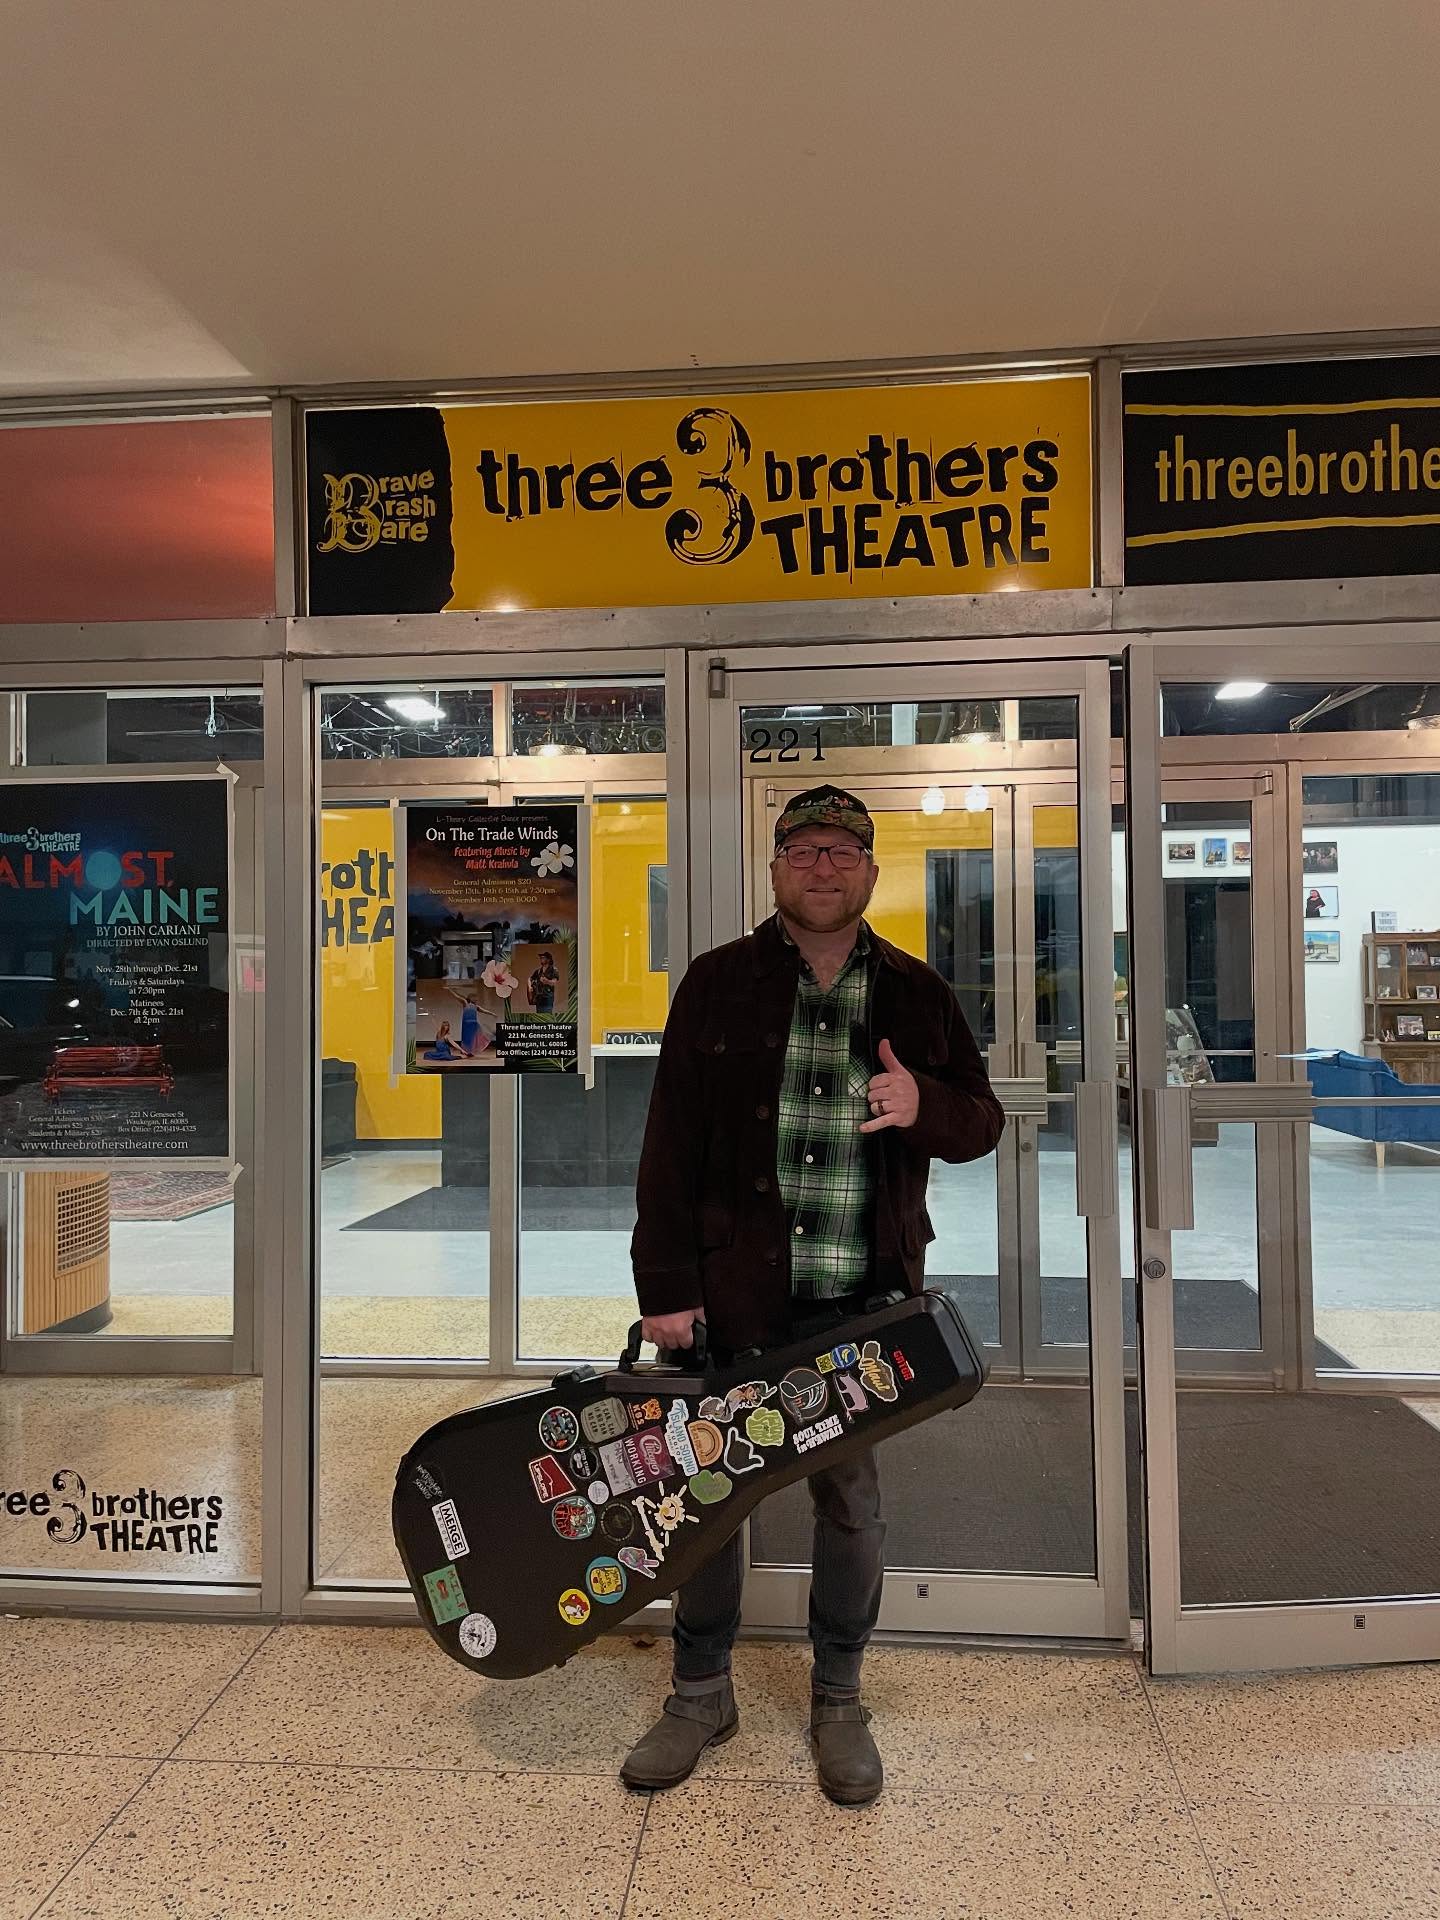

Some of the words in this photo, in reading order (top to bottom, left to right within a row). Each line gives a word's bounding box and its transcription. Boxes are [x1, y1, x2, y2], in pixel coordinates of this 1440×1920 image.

[477, 450, 673, 522] three
[764, 432, 1059, 504] brothers
[760, 496, 1051, 576] THEATRE
[749, 726, 826, 764] 221
[40, 832, 81, 842] brothers
[425, 827, 446, 841] On
[449, 827, 475, 841] The
[477, 827, 515, 841] Trade
[517, 826, 558, 840] Winds
[40, 841, 80, 852] THEATRE
[454, 847, 493, 858] Featuring
[494, 846, 518, 857] Music
[519, 846, 531, 858] by
[465, 860, 487, 870] Matt
[429, 887, 463, 895] November
[69, 887, 219, 925] MAINE
[448, 896, 482, 904] November
[96, 926, 110, 937] BY
[113, 925, 146, 938] JOHN
[149, 924, 200, 936] CARIANI
[87, 939, 132, 948] DIRECTED
[134, 939, 144, 947] BY
[146, 938, 170, 947] EVAN
[171, 937, 208, 946] OSLUND
[115, 965, 131, 973] 28th
[133, 965, 163, 975] through
[165, 964, 181, 973] Dec.
[183, 964, 198, 972] 21st
[109, 978, 137, 987] Fridays
[147, 977, 185, 987] Saturdays
[128, 987, 136, 995] at
[137, 987, 165, 996] 7:30pm
[130, 1000, 164, 1008] Matinees
[110, 1008, 127, 1016] Dec.
[128, 1008, 140, 1016] 7th
[151, 1008, 168, 1016] Dec.
[168, 1008, 184, 1016] 21st
[142, 1017, 160, 1026] 2pm
[504, 1041, 539, 1049] Waukegan,
[20, 1139, 188, 1151] www.threebrotherstheatre.com
[671, 1414, 687, 1442] ISLAND
[680, 1444, 696, 1473] SOUND
[624, 1438, 647, 1484] WORKING
[533, 1463, 549, 1498] UPSLOPE
[92, 1487, 223, 1521] brothers
[442, 1507, 463, 1551] MERGE
[90, 1519, 219, 1554] THEATRE
